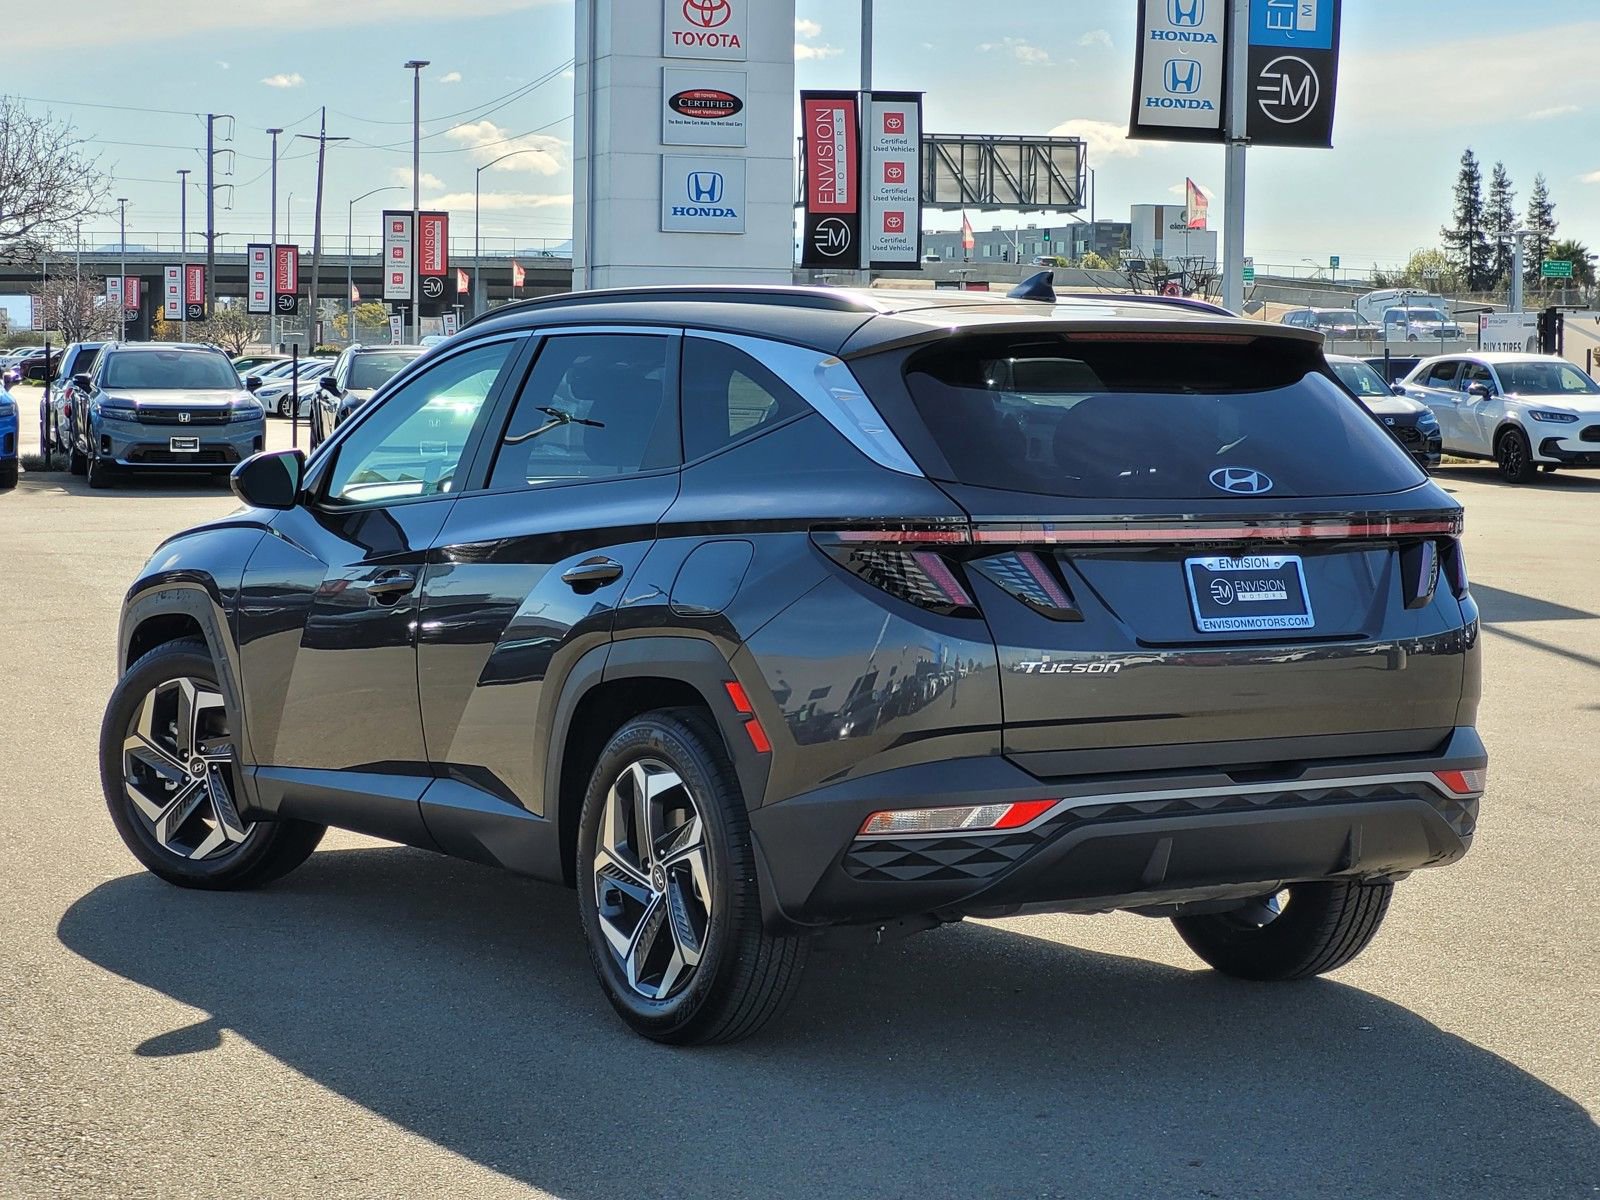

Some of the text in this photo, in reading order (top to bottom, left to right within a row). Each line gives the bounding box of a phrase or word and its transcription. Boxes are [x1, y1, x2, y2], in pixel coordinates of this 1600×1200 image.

[672, 31, 741, 48] TOYOTA
[1150, 30, 1218, 43] HONDA
[678, 98, 734, 108] CERTIFIED
[1145, 97, 1215, 110] HONDA
[815, 108, 834, 204] ENVISION
[836, 117, 845, 195] MOTORS
[671, 206, 738, 218] HONDA
[425, 220, 435, 271] ENVISION
[1483, 342, 1497, 352] BUY
[1502, 342, 1522, 352] TIRES
[1218, 557, 1270, 569] ENVISION
[1234, 579, 1286, 592] ENVISION
[1203, 617, 1310, 630] ENVISIONMOTORS.COM
